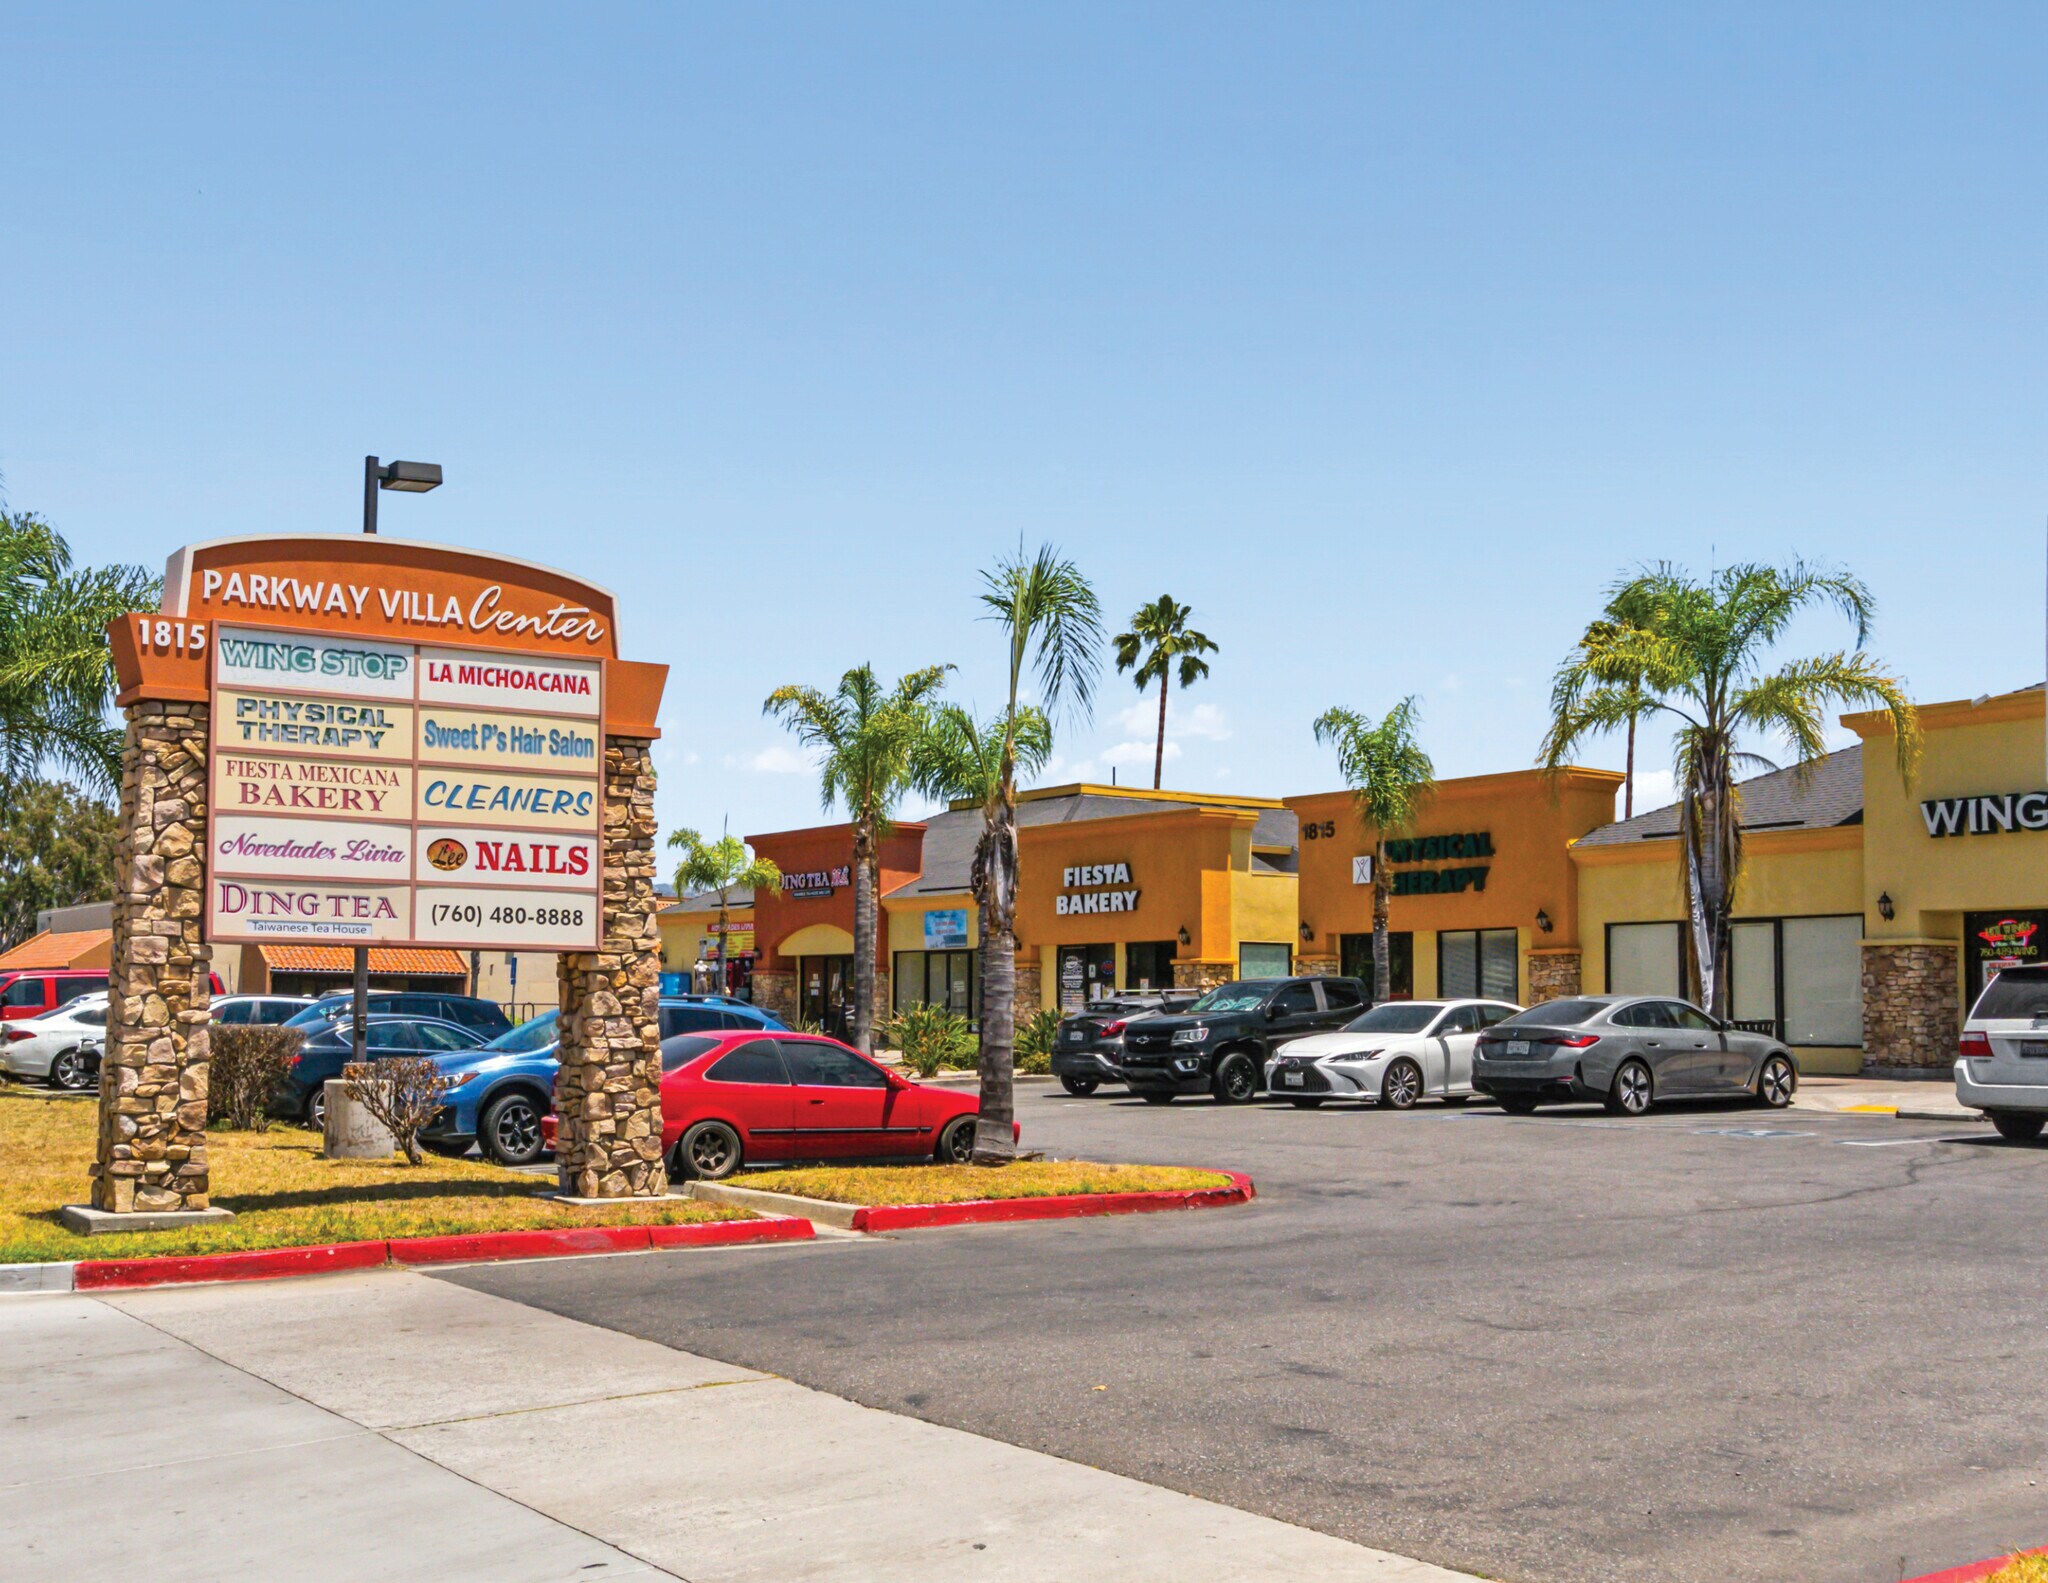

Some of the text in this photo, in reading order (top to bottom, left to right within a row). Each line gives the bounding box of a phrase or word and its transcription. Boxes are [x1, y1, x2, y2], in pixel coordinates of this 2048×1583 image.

[203, 569, 604, 641] PARKWAY VILLA Center
[140, 620, 206, 650] 1815
[220, 639, 408, 680] WING STOP
[428, 663, 591, 695] LA MICHOACANA
[236, 698, 394, 729] PHYSICAL
[236, 720, 386, 749] THERAPY
[424, 719, 594, 759] Sweet P's Hair Salon
[226, 760, 400, 787] FIESTA MEXICANA
[238, 782, 388, 812] BAKERY
[424, 780, 593, 817] CLEANERS
[1920, 793, 2048, 835] WING
[1302, 820, 1335, 840] 1815
[219, 832, 406, 863] Novedades Livia
[432, 843, 465, 866] Lee
[475, 841, 589, 876] NAILS
[1063, 863, 1130, 888] FIESTA
[218, 883, 398, 919] DING TEA
[431, 904, 584, 927] (760) 480-8888
[1056, 890, 1138, 915] BAKERY
[252, 921, 367, 934] Taiwanese Tea House
